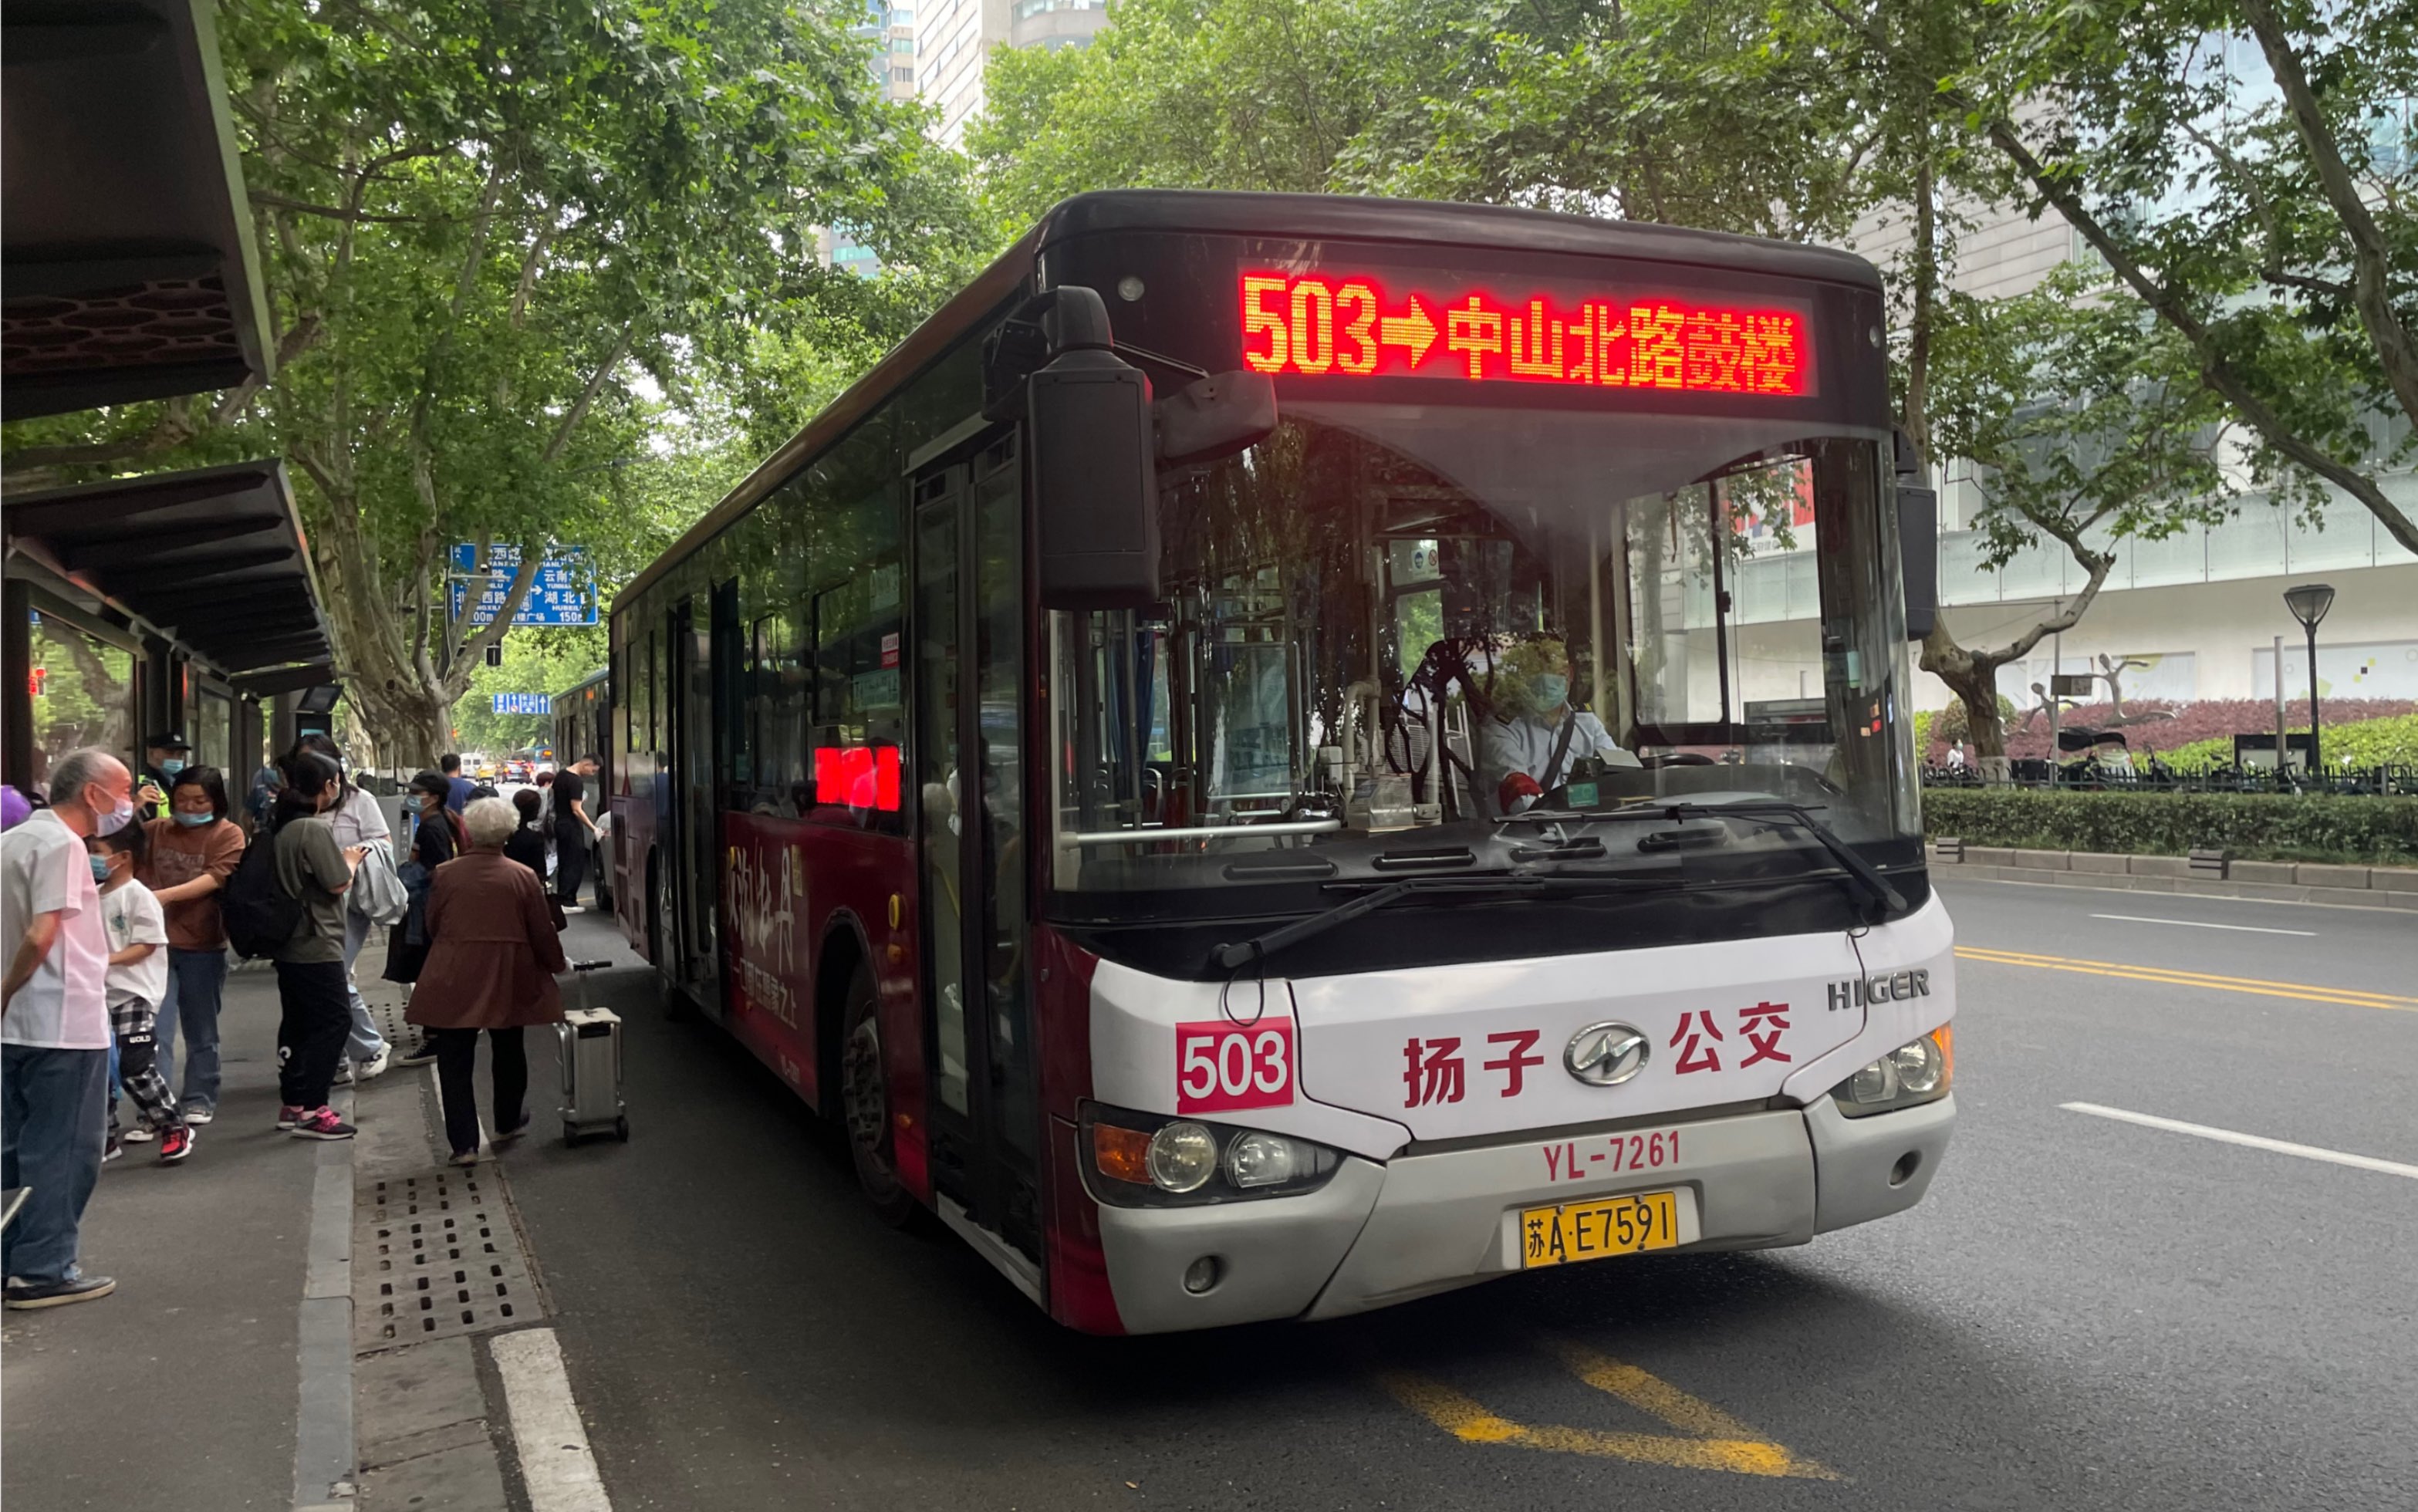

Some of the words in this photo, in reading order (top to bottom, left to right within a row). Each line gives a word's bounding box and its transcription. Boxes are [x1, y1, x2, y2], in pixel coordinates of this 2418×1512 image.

[1243, 266, 1376, 375] 503
[1447, 295, 1796, 392] 中山北路鼓楼
[1827, 968, 1930, 1011] HIGER
[1182, 1031, 1288, 1099] 503
[1403, 1029, 1545, 1109] 扬子
[1669, 1001, 1792, 1075] 公交
[1543, 1131, 1679, 1182] YL-7261
